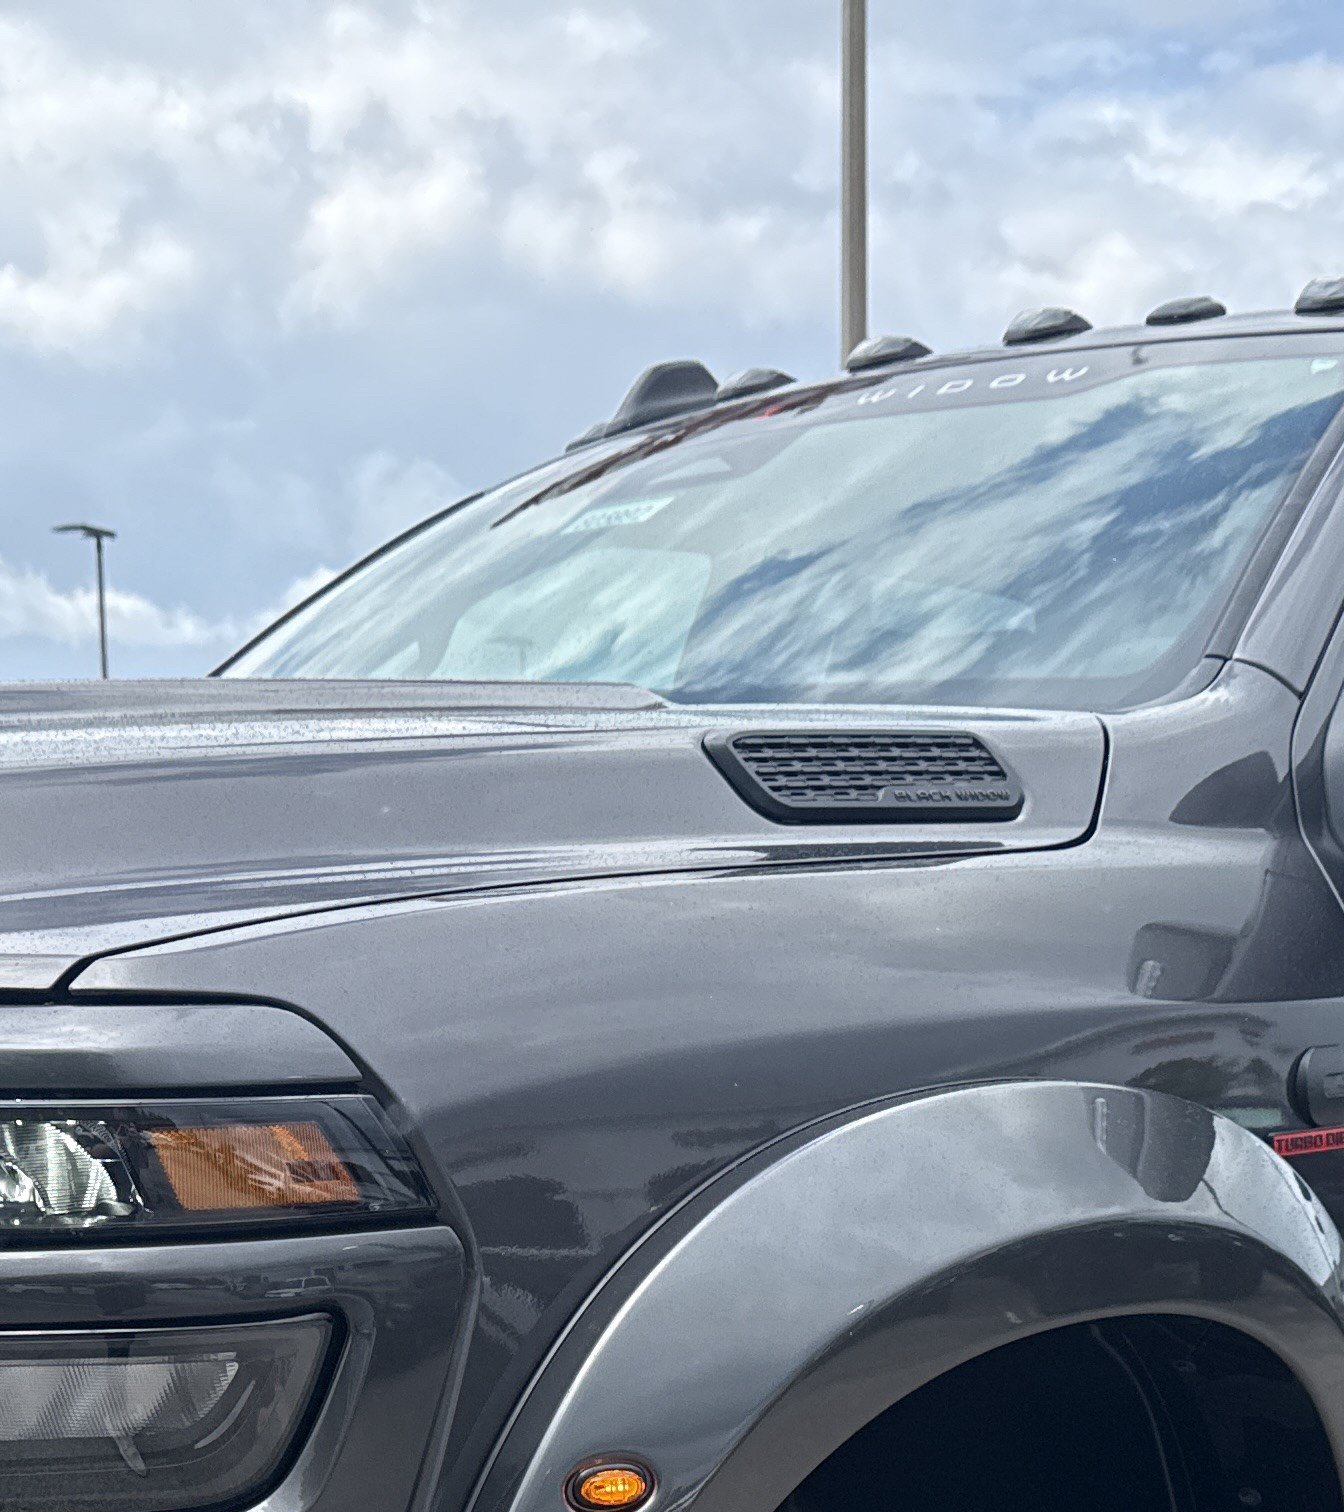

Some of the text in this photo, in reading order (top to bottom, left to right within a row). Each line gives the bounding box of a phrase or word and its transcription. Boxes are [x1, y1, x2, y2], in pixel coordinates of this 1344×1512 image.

[857, 365, 1090, 405] WIDOW
[893, 789, 1011, 802] BLACK WIDOW
[1276, 1135, 1323, 1152] TURBO
